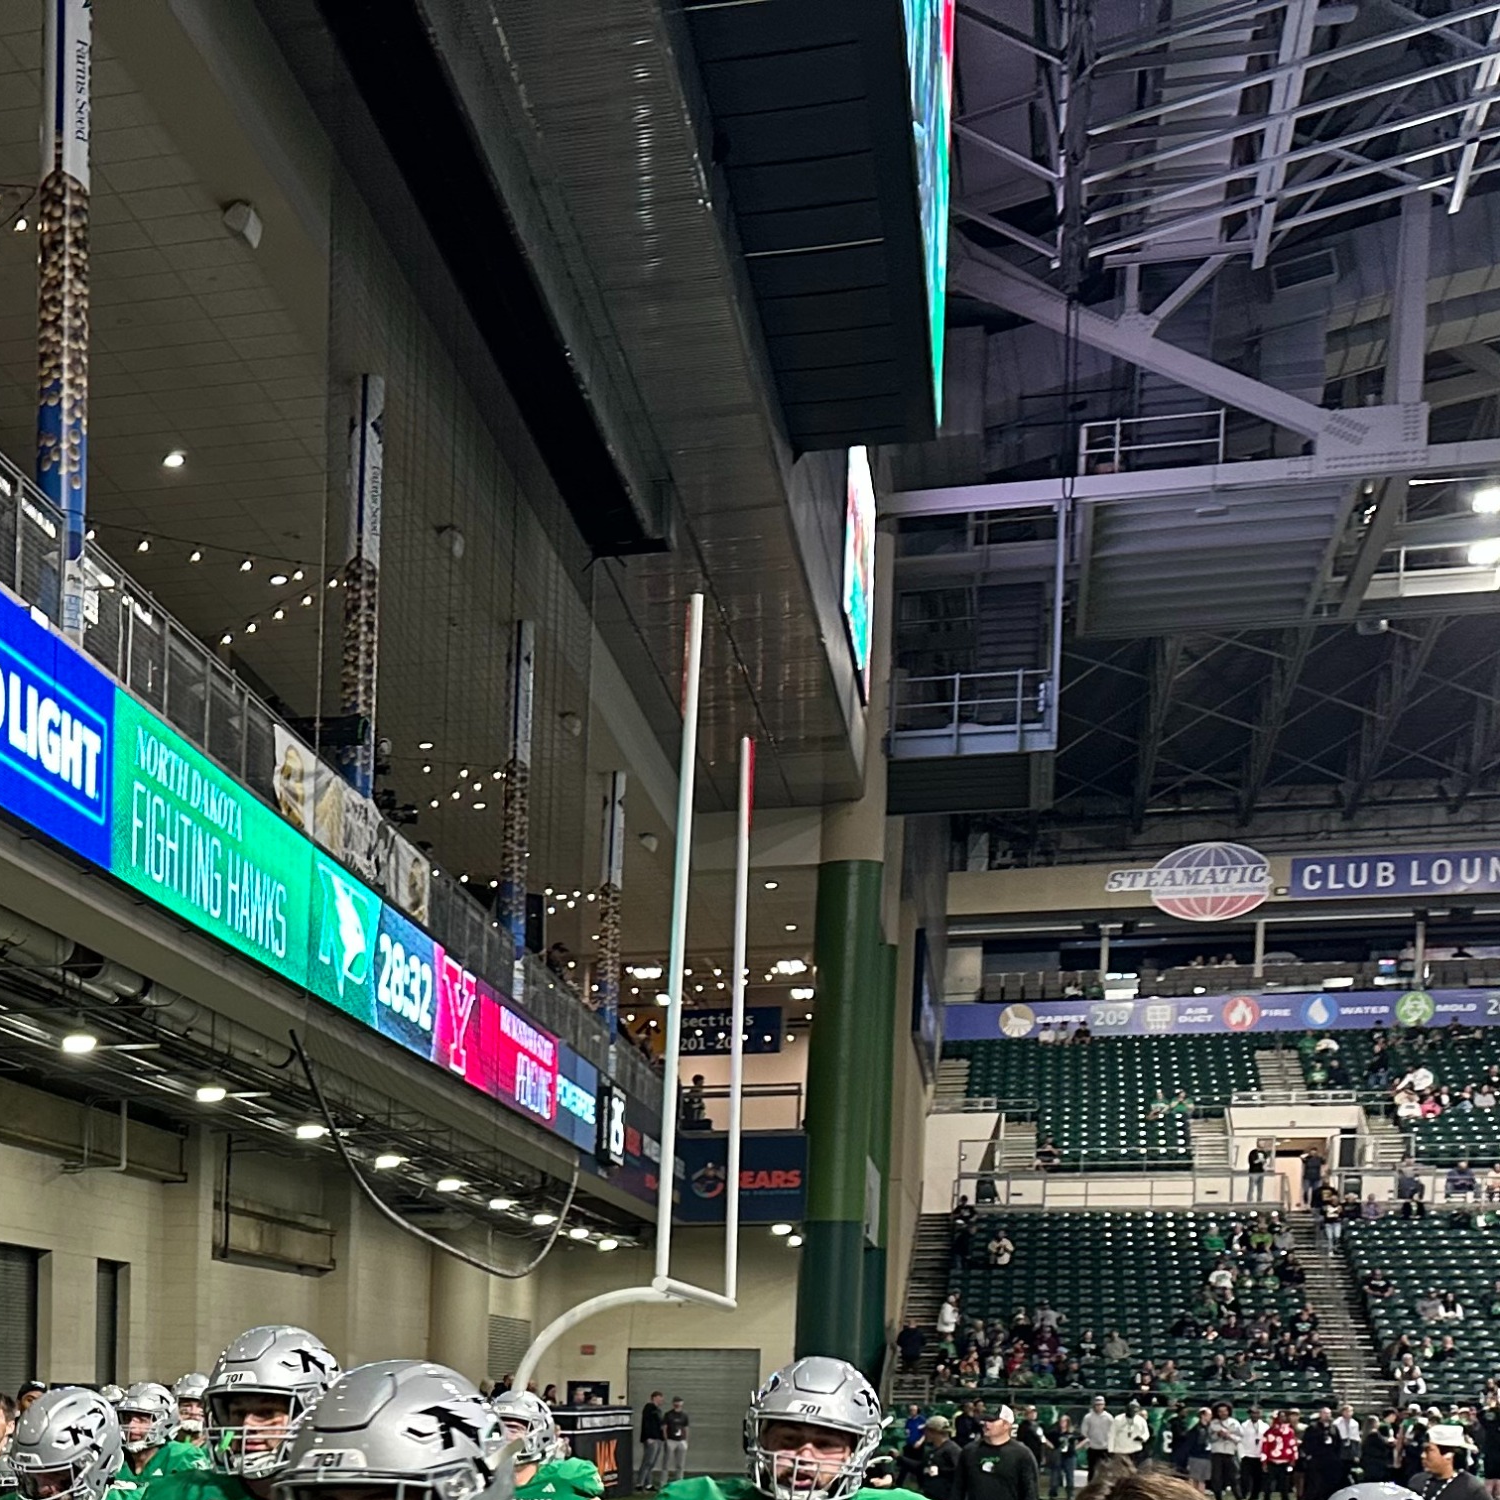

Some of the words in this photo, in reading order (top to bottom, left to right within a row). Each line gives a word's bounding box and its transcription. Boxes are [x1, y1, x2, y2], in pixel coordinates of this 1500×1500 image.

[75, 39, 89, 94] Farms
[75, 98, 89, 142] Seed
[8, 673, 100, 800] LIGHT
[134, 725, 190, 800] NORTH
[190, 765, 244, 842] DAKOTA
[131, 780, 223, 919] FIGHTING
[226, 848, 288, 959] HAWKS
[1108, 866, 1267, 890] STEAMATIC
[1302, 862, 1396, 890] CLUB
[377, 932, 432, 1031] 28:32
[1185, 1007, 1210, 1015] AIR
[1261, 1009, 1291, 1017] FIRE
[1339, 1005, 1390, 1015] WATER
[1435, 1003, 1477, 1013] MOLD
[1486, 998, 1500, 1016] 2
[681, 1013, 755, 1028] sectios
[1036, 1014, 1088, 1024] CARPET
[1093, 1010, 1130, 1026] 209
[1178, 1013, 1215, 1024] DUCT
[738, 1169, 802, 1189] EARS
[225, 1372, 245, 1384] 701
[799, 1402, 823, 1416] 701
[312, 1451, 346, 1468] 701
